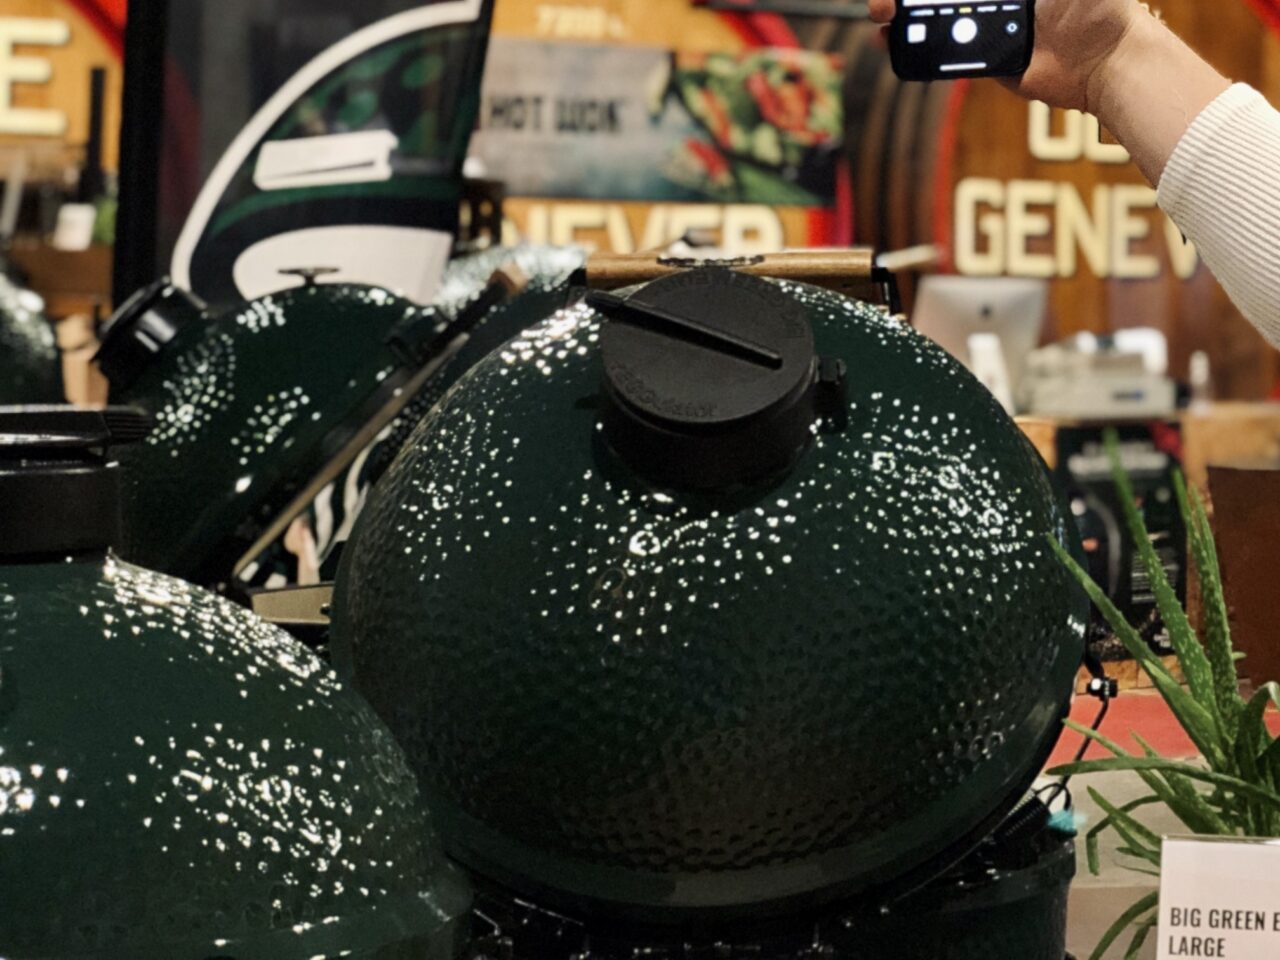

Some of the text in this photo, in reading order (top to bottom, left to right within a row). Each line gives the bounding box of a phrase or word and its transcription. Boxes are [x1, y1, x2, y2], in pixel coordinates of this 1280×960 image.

[1170, 907, 1201, 928] BIG
[1208, 908, 1266, 931] GREEN
[1168, 935, 1226, 957] LARGE
